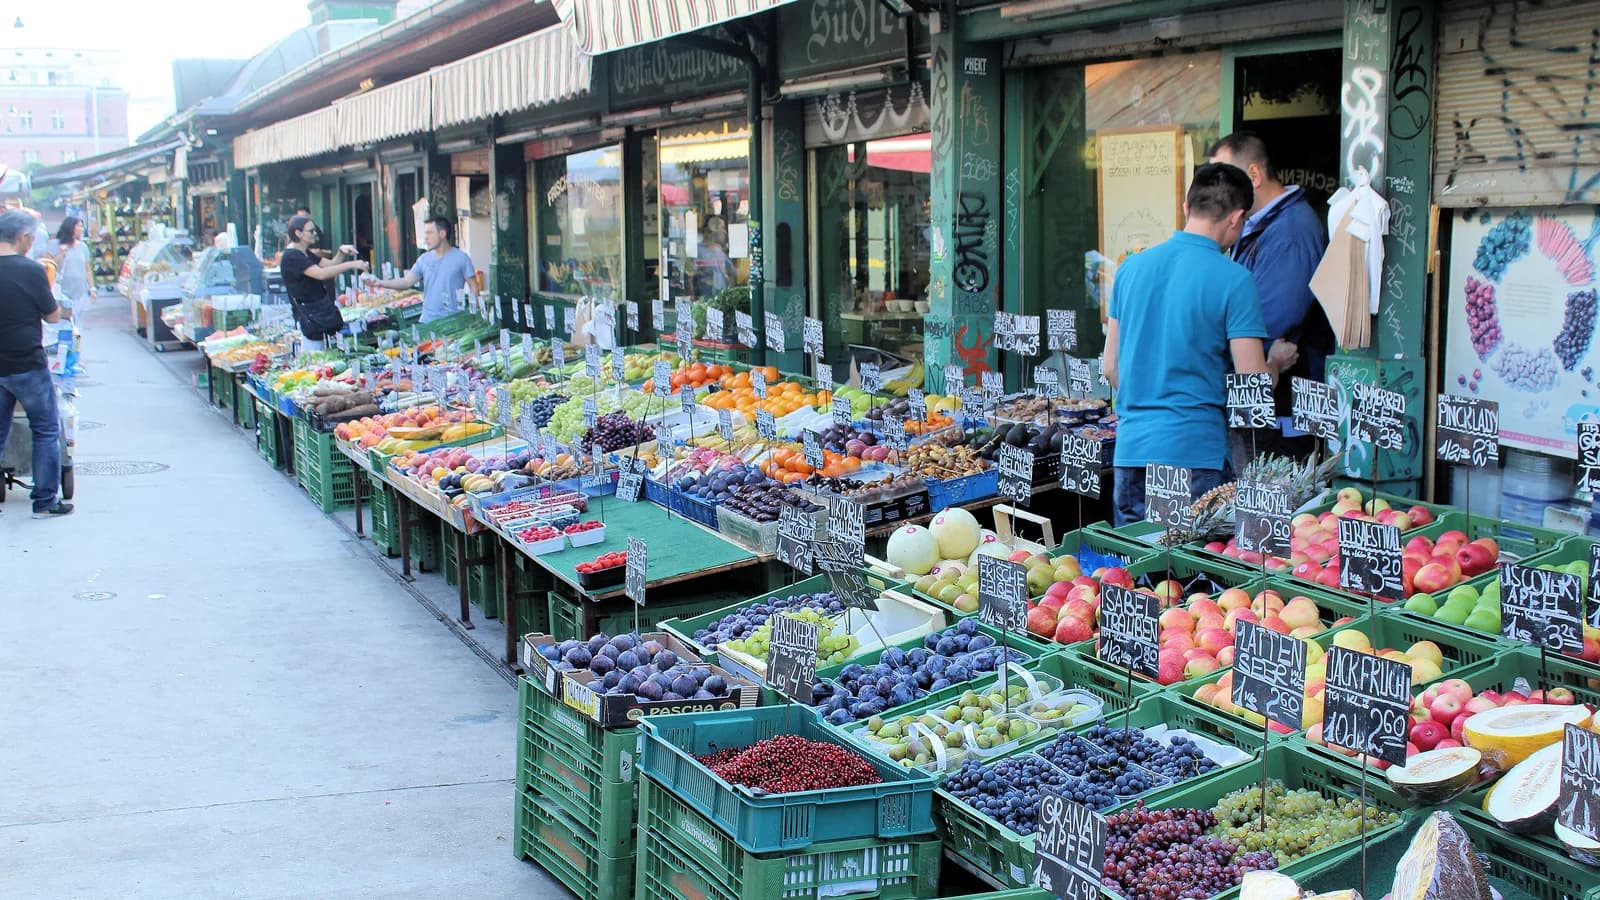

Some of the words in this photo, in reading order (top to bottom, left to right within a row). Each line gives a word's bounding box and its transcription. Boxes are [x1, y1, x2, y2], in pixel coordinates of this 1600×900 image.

[1226, 374, 1260, 389] FLUG
[1226, 388, 1274, 407] ANANAS
[1295, 393, 1339, 415] ANANAS
[1438, 402, 1499, 434] PINCKLADY
[1062, 434, 1101, 459] BOSKOP
[1146, 463, 1190, 492] ELSTAR
[830, 496, 865, 525] VIKTORIA
[1236, 487, 1292, 514] GALAROYAL
[980, 562, 1025, 587] FRISCHE
[980, 578, 1021, 602] FEIGEN
[1101, 585, 1149, 617] ISABEL
[1507, 585, 1559, 611] APFEL
[1102, 610, 1158, 643] TRAUBEN
[1235, 621, 1303, 671] PLATTEN
[1238, 653, 1288, 687] SEER
[650, 704, 714, 716] PASCHA
[1042, 795, 1106, 846] GRANAT
